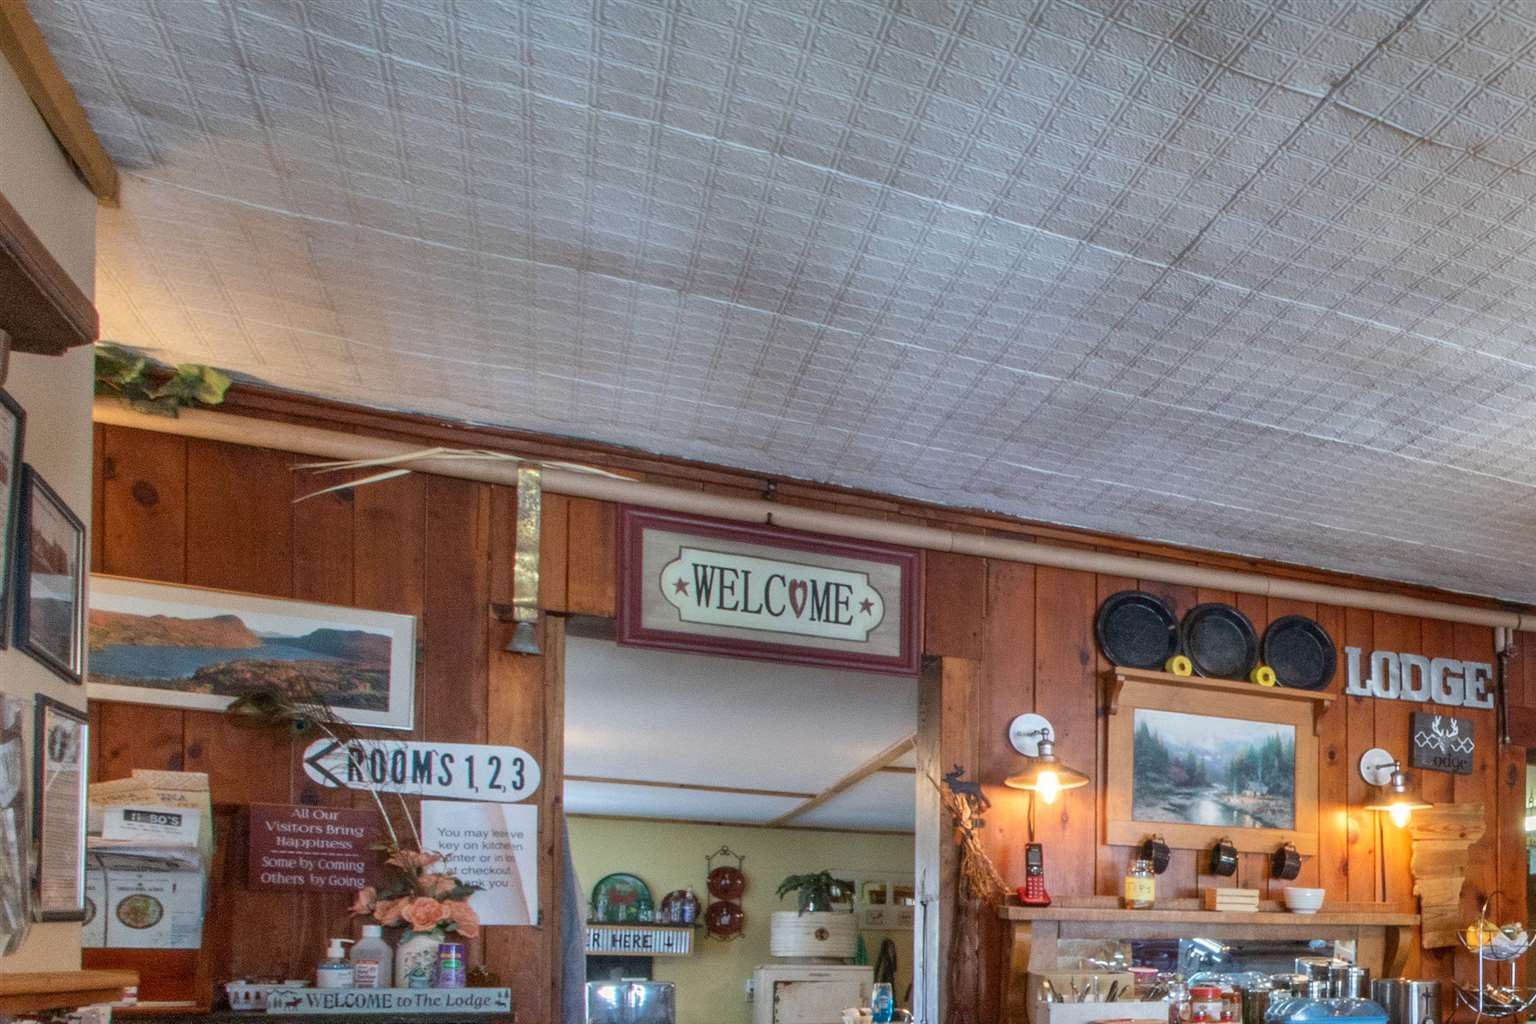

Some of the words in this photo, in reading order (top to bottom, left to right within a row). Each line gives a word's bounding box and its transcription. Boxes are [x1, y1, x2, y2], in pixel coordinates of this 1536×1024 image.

[1344, 646, 1494, 709] LODGE
[348, 748, 455, 787] ROOMS
[292, 808, 310, 818] All
[313, 809, 339, 820] Our
[265, 821, 323, 834] Visitors
[326, 824, 364, 838] Bring
[438, 827, 461, 839] You
[464, 830, 489, 841] may
[276, 836, 353, 849] Happiness
[439, 841, 460, 852] key
[464, 842, 479, 851] on
[262, 856, 297, 868] Some
[299, 857, 314, 871] by
[318, 859, 365, 873] Coming
[479, 855, 491, 863] or
[261, 872, 304, 885] Others
[310, 874, 325, 887] by
[329, 875, 365, 888] Going
[612, 933, 652, 949] HERE
[305, 992, 393, 1010] WELCOME
[396, 996, 414, 1009] to
[414, 993, 442, 1008] The
[446, 993, 491, 1009] Lodge
